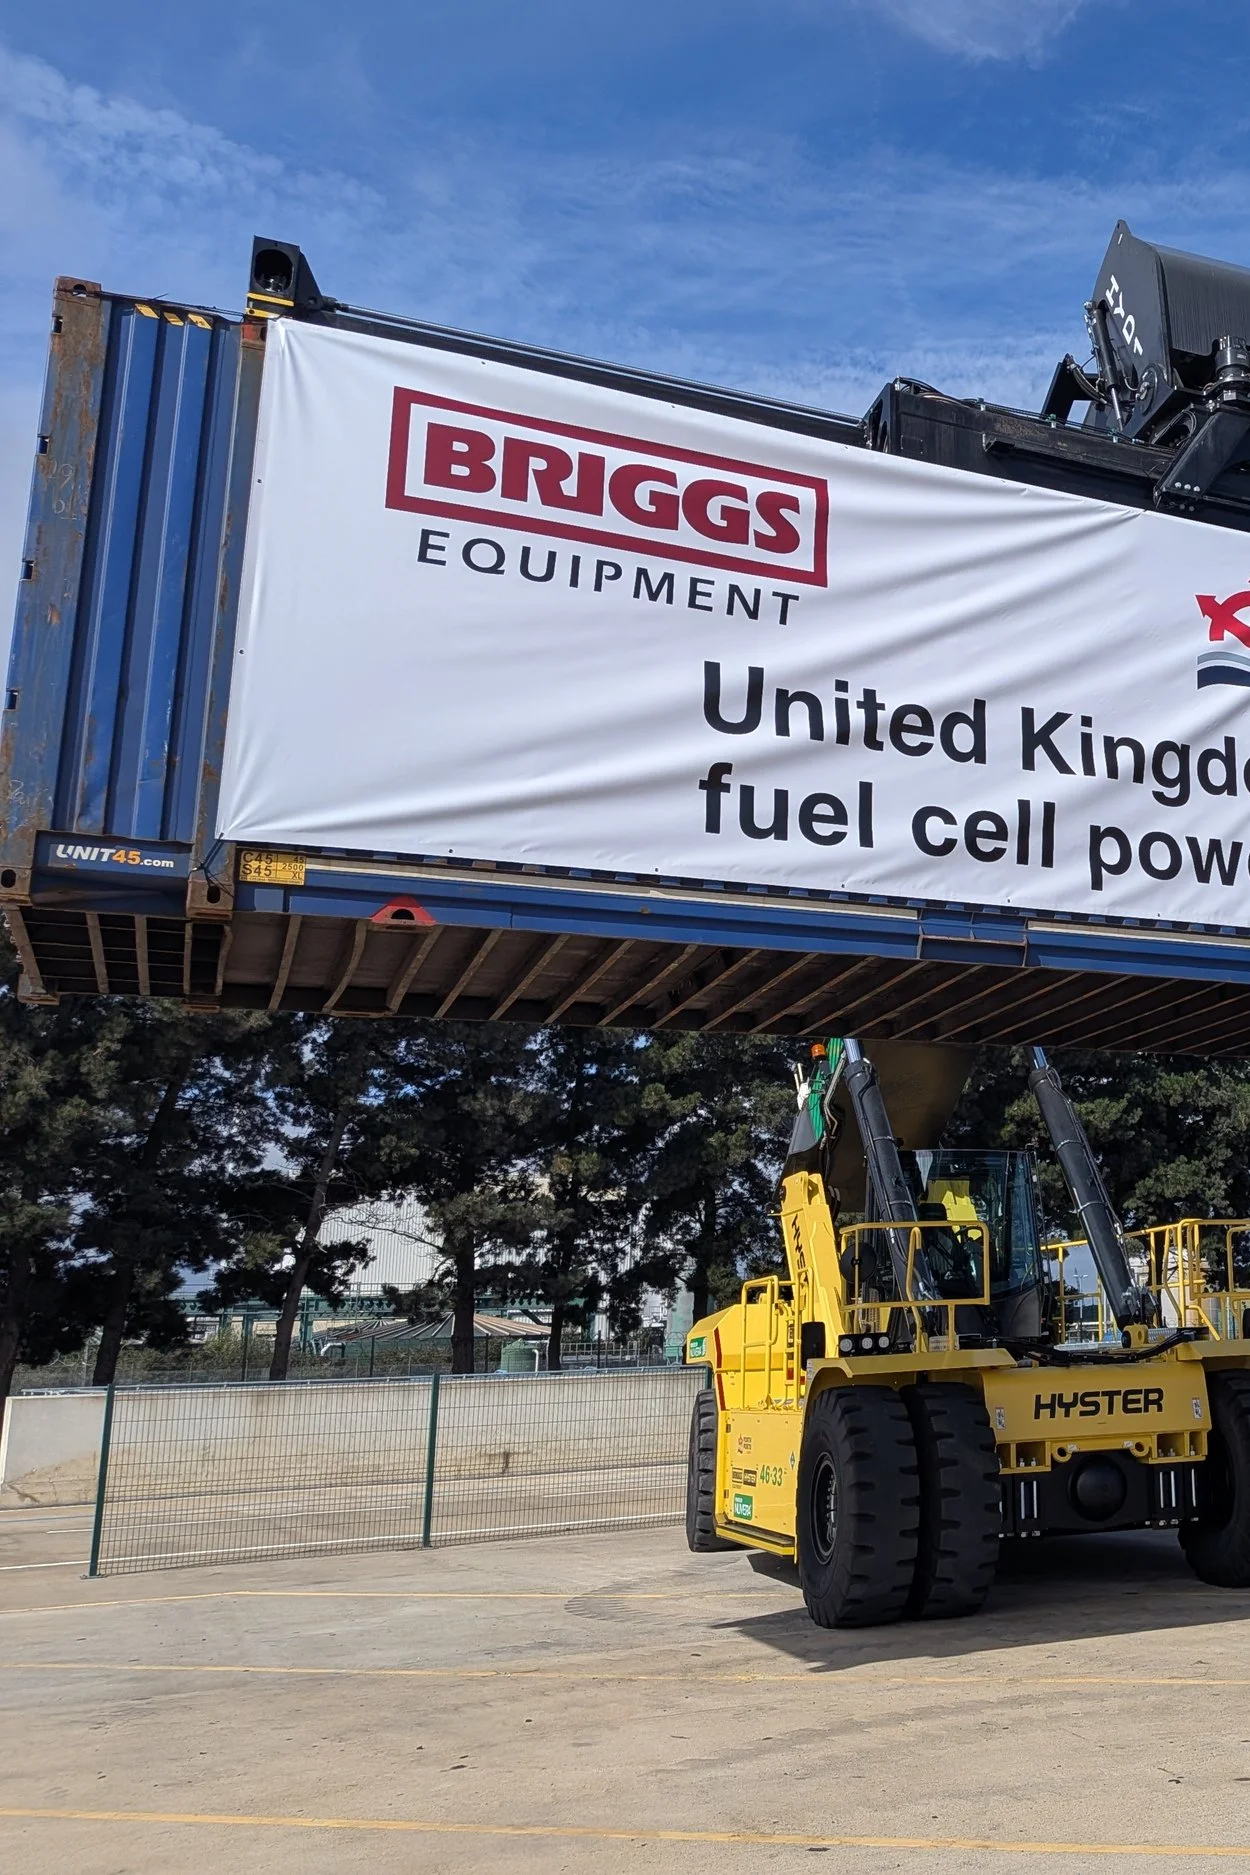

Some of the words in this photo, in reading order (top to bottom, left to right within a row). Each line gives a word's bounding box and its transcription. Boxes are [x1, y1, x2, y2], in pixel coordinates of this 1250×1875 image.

[424, 422, 801, 554] BRIGGS
[418, 529, 801, 626] EQUIPMENT
[703, 661, 988, 766] United
[699, 762, 874, 849] fuel
[911, 800, 1056, 869] cell
[56, 844, 174, 868] UNIT45.com
[242, 864, 272, 877] S45
[243, 852, 273, 865] C45
[282, 863, 304, 871] 2500
[1034, 1387, 1164, 1420] HYSTER
